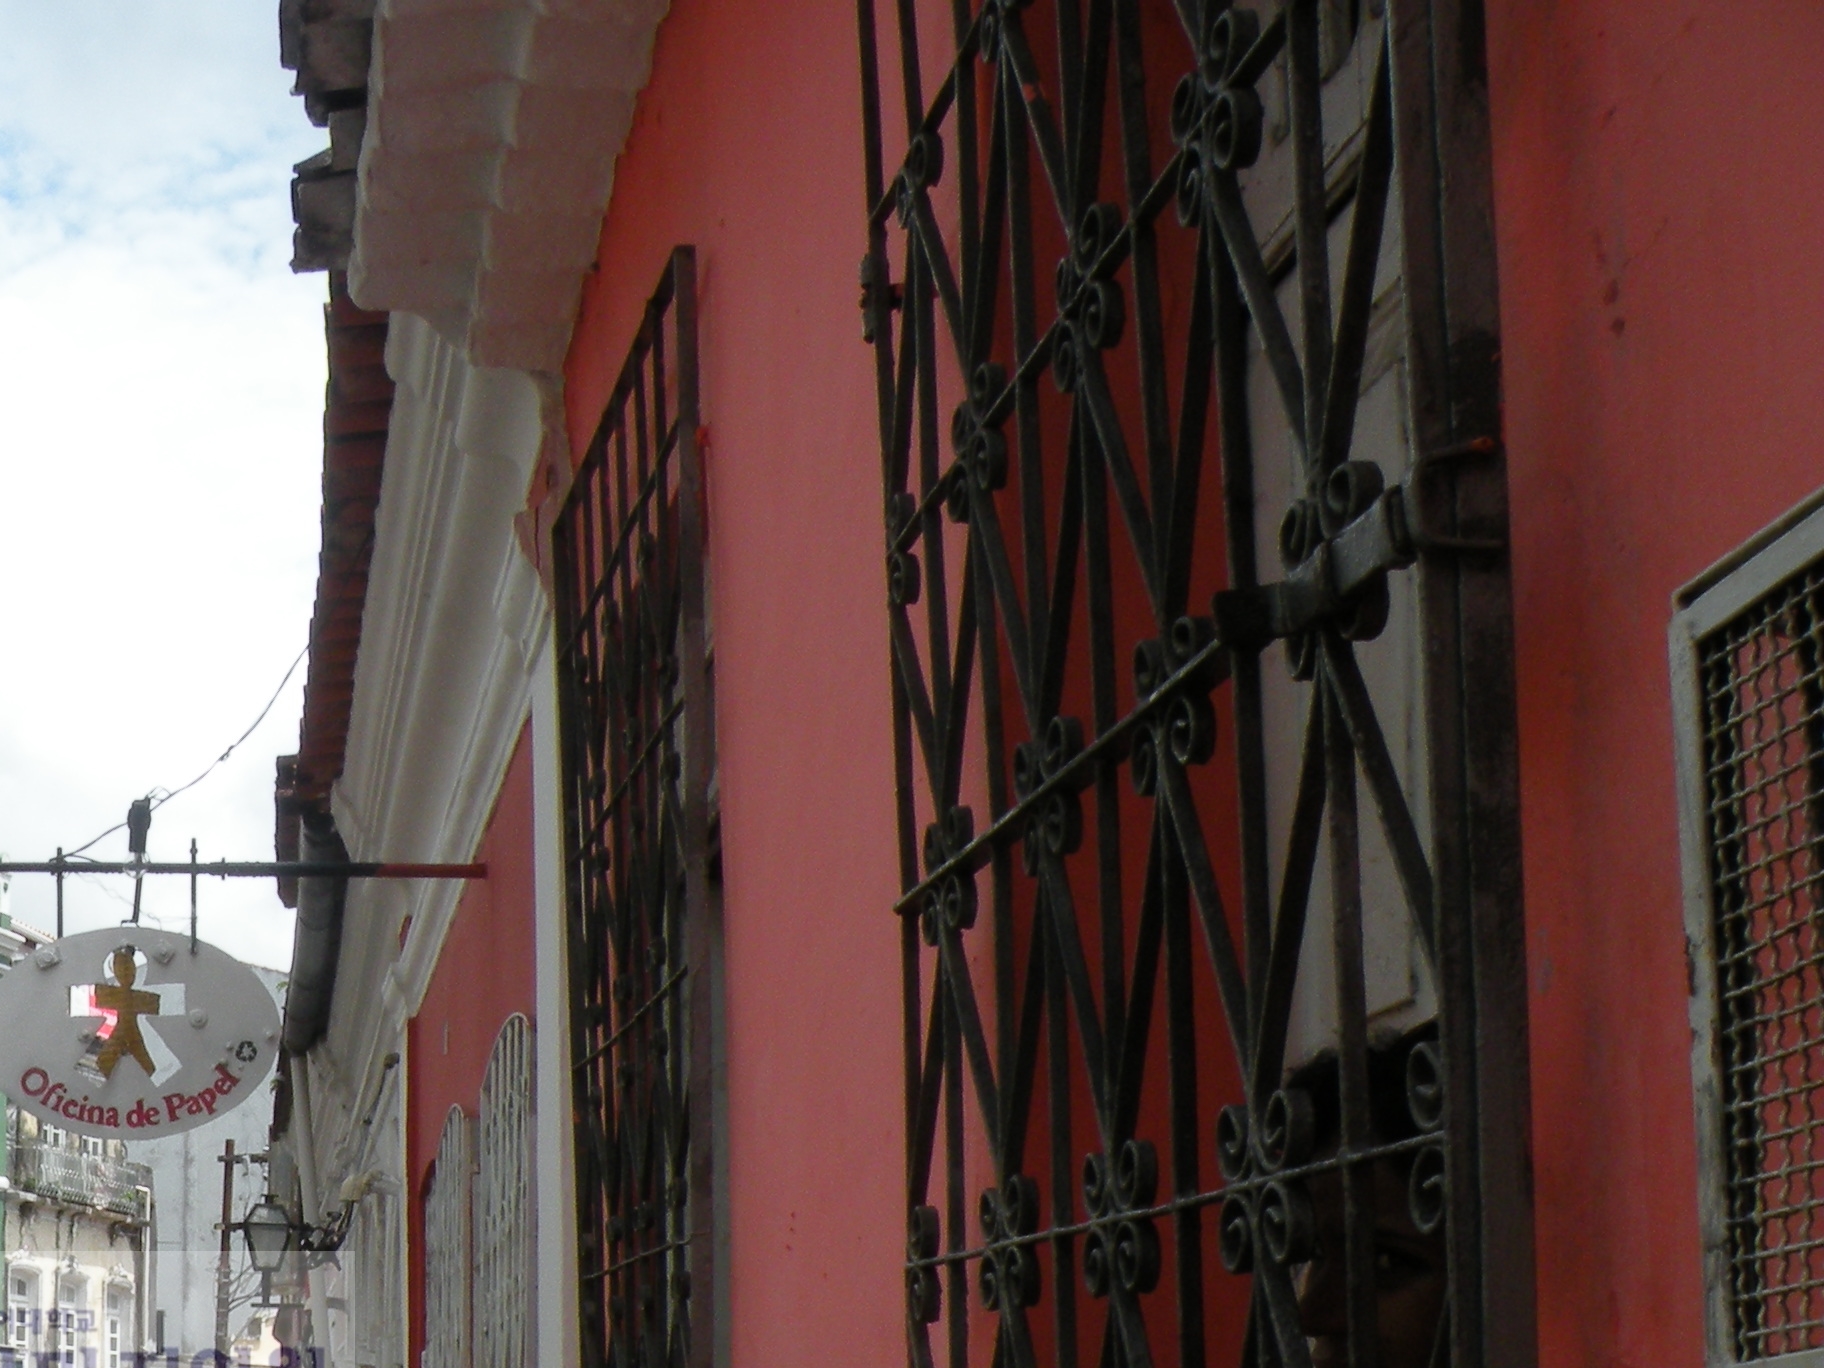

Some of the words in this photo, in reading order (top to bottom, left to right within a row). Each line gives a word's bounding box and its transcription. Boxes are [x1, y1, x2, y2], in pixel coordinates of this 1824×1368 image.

[20, 1067, 120, 1128] Oficina
[126, 1098, 161, 1129] de
[162, 1062, 241, 1122] Papel
